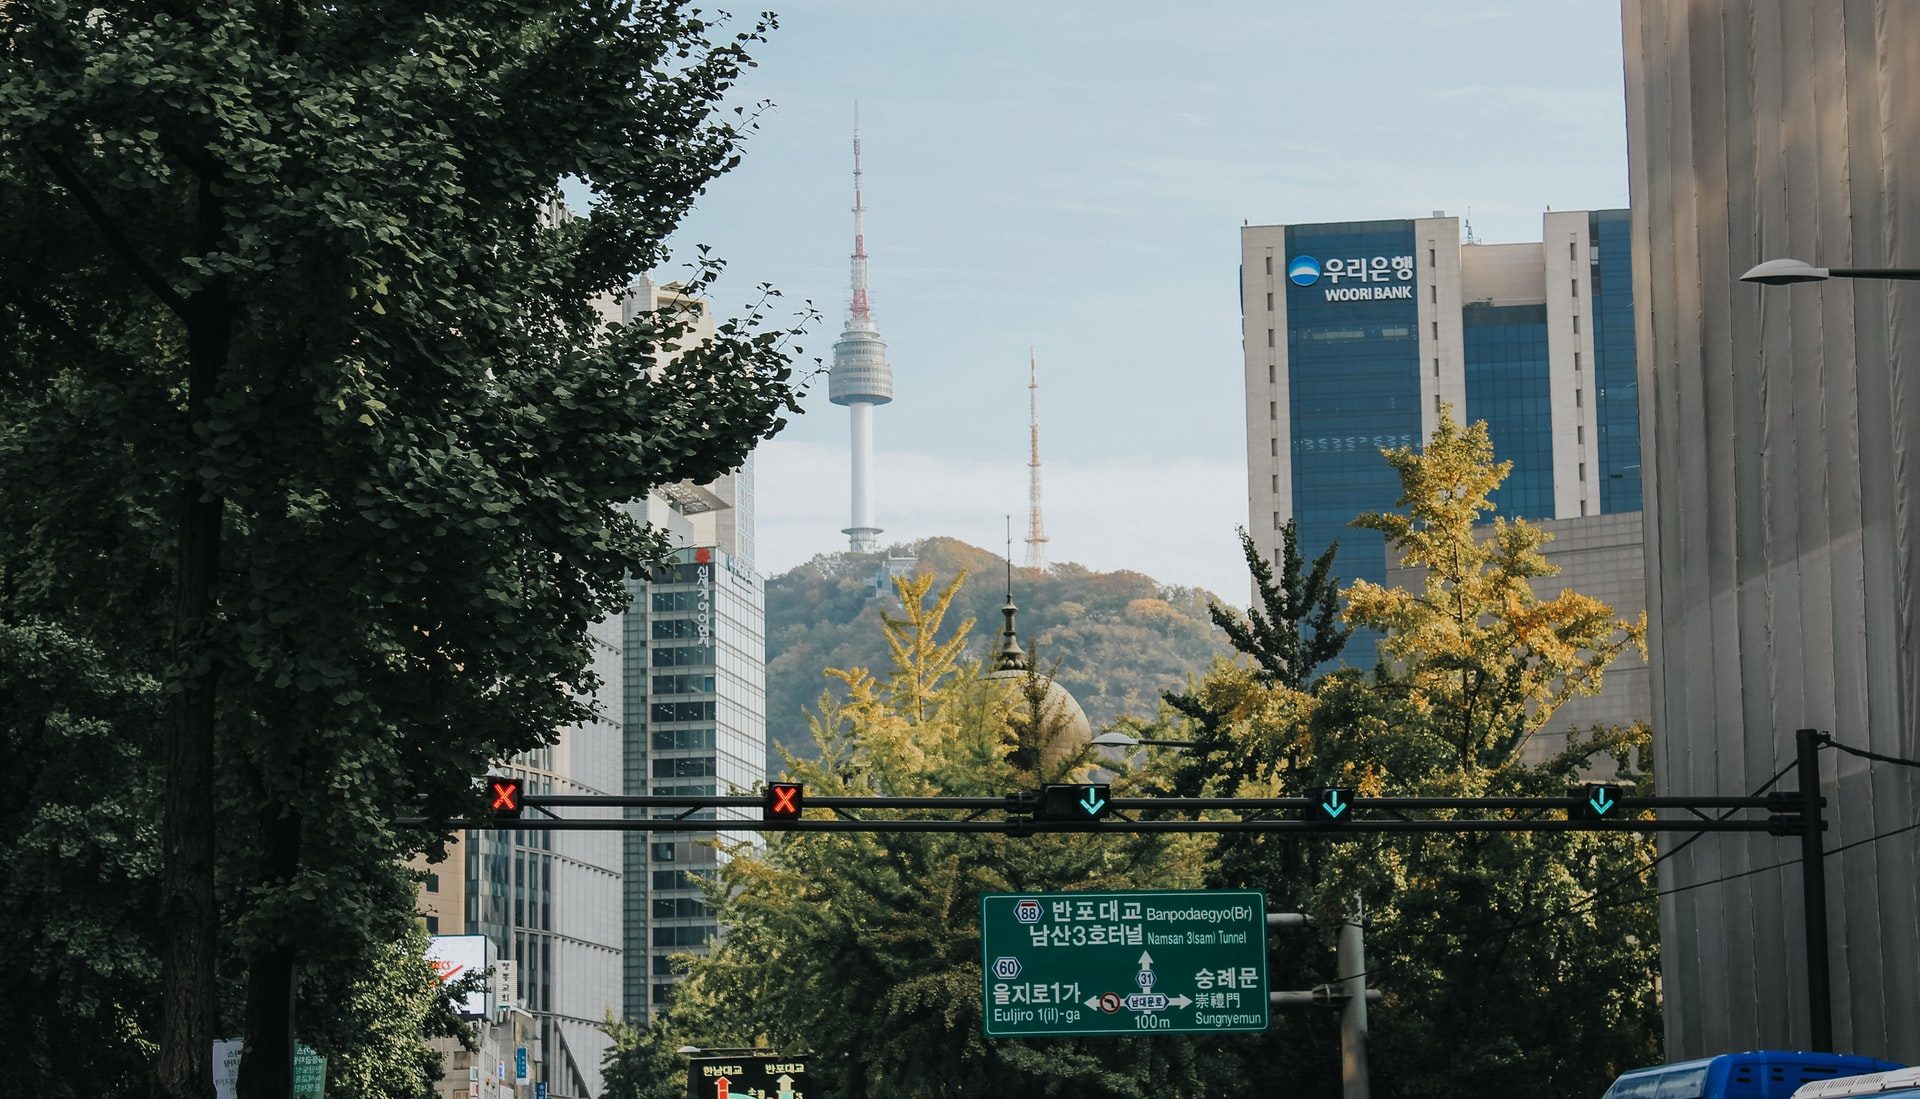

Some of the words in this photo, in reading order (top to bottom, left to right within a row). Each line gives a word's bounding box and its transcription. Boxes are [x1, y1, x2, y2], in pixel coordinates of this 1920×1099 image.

[1323, 256, 1413, 284] 우리은행
[1325, 288, 1372, 301] WOORI
[1374, 286, 1412, 300] BANK
[1021, 907, 1036, 920] 88
[1052, 900, 1143, 922] 반포대교
[1146, 905, 1252, 923] Banpodaegyo(Br)
[1030, 923, 1143, 947] 남산3호터널
[1147, 932, 1184, 945] Namsan
[1218, 930, 1247, 944] Tunnel
[1000, 961, 1015, 975] 60
[1140, 973, 1152, 984] 31
[1195, 967, 1259, 989] 숭례문
[993, 982, 1081, 1005] 을지로1가
[1195, 992, 1241, 1009] 崇禮門
[994, 1008, 1033, 1024] Euljiro
[1195, 1012, 1261, 1027] Sungnyemun
[703, 1065, 743, 1077] 한남대교
[765, 1063, 805, 1075] 반포대교
